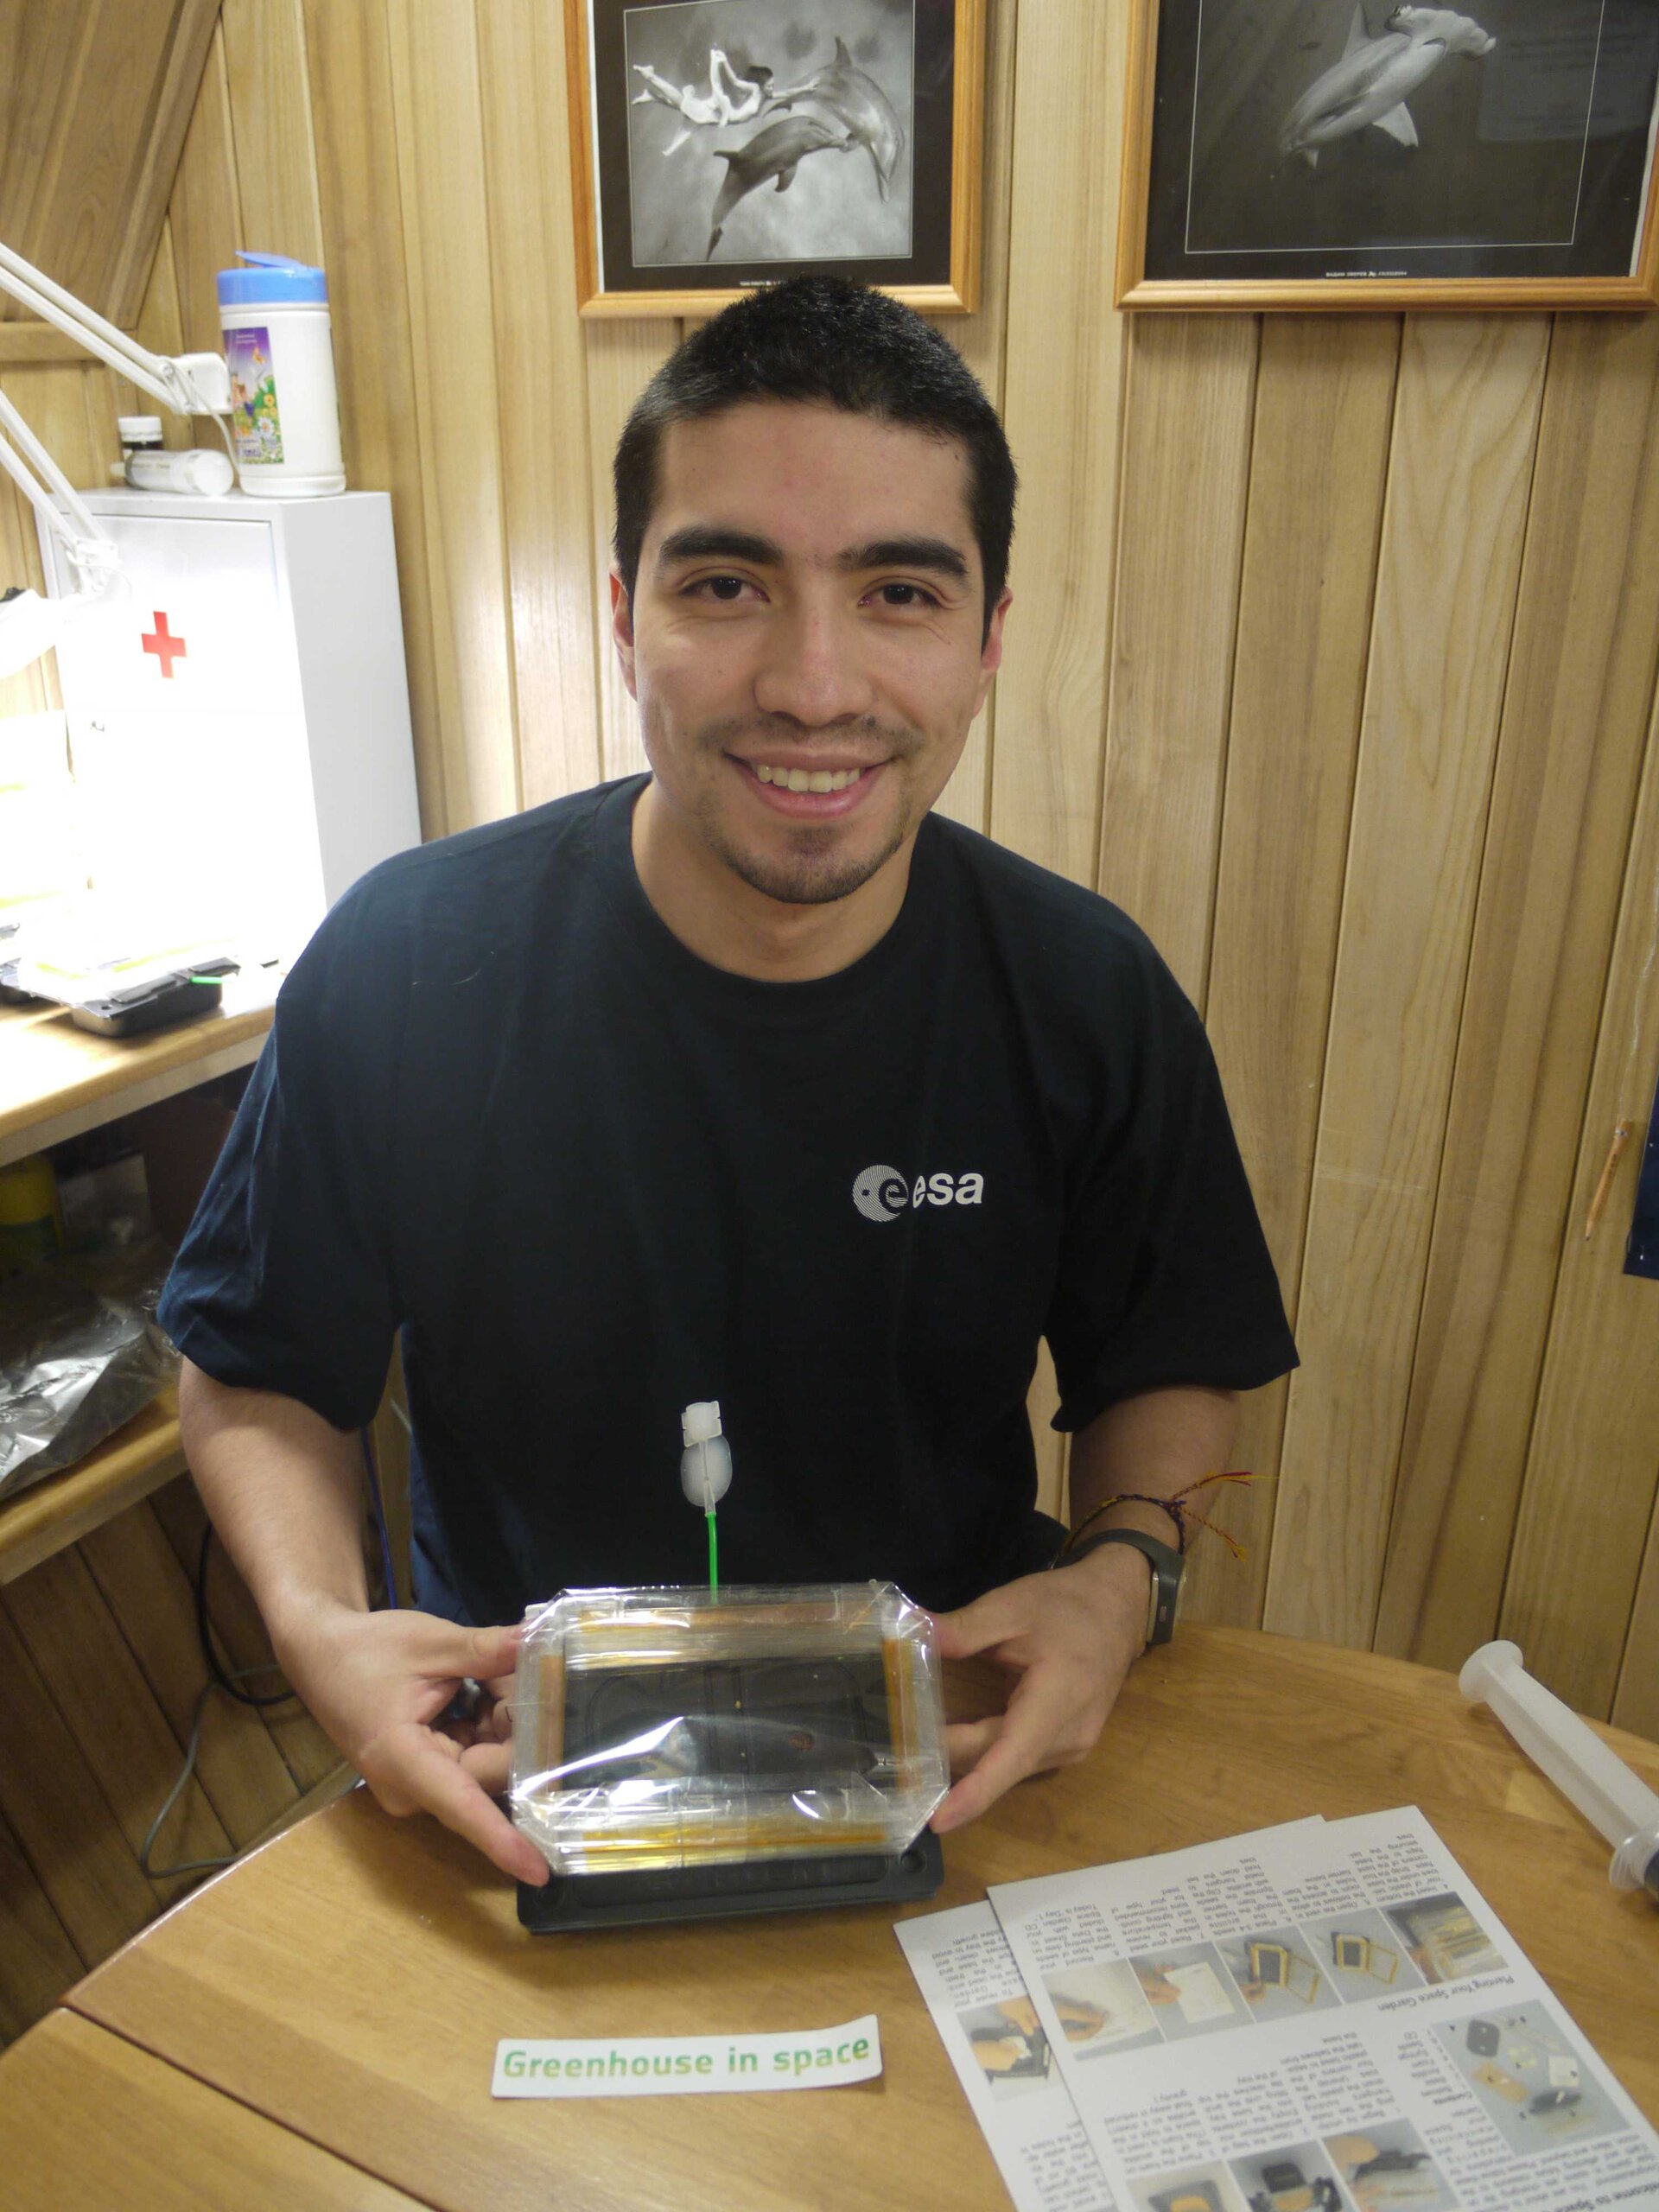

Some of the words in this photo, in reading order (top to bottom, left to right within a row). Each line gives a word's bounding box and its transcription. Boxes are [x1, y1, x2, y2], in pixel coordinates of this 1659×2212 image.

[504, 2049, 713, 2078] Greenhouse
[728, 2046, 758, 2073] in
[772, 2037, 870, 2076] space
